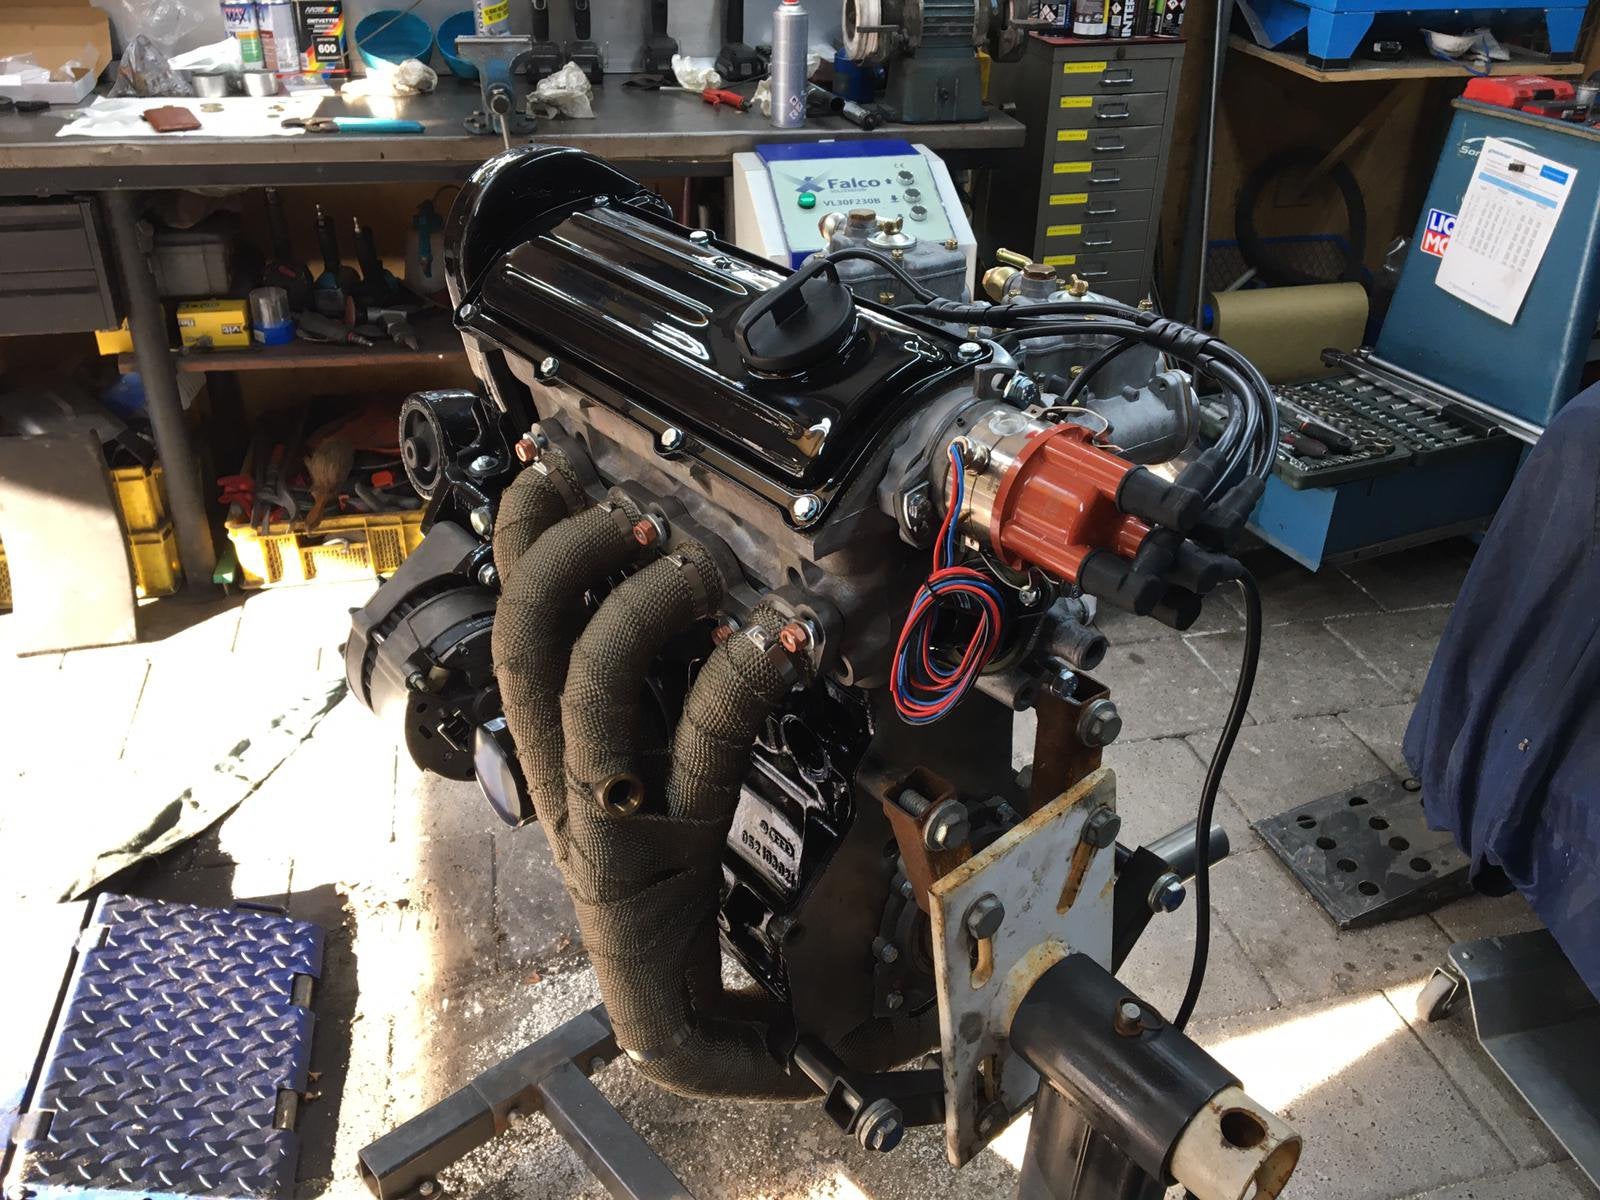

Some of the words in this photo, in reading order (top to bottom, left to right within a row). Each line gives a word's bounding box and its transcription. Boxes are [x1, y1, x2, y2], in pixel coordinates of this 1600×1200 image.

[317, 43, 337, 54] 600
[827, 177, 880, 190] Falco
[823, 197, 882, 207] VL30F230B
